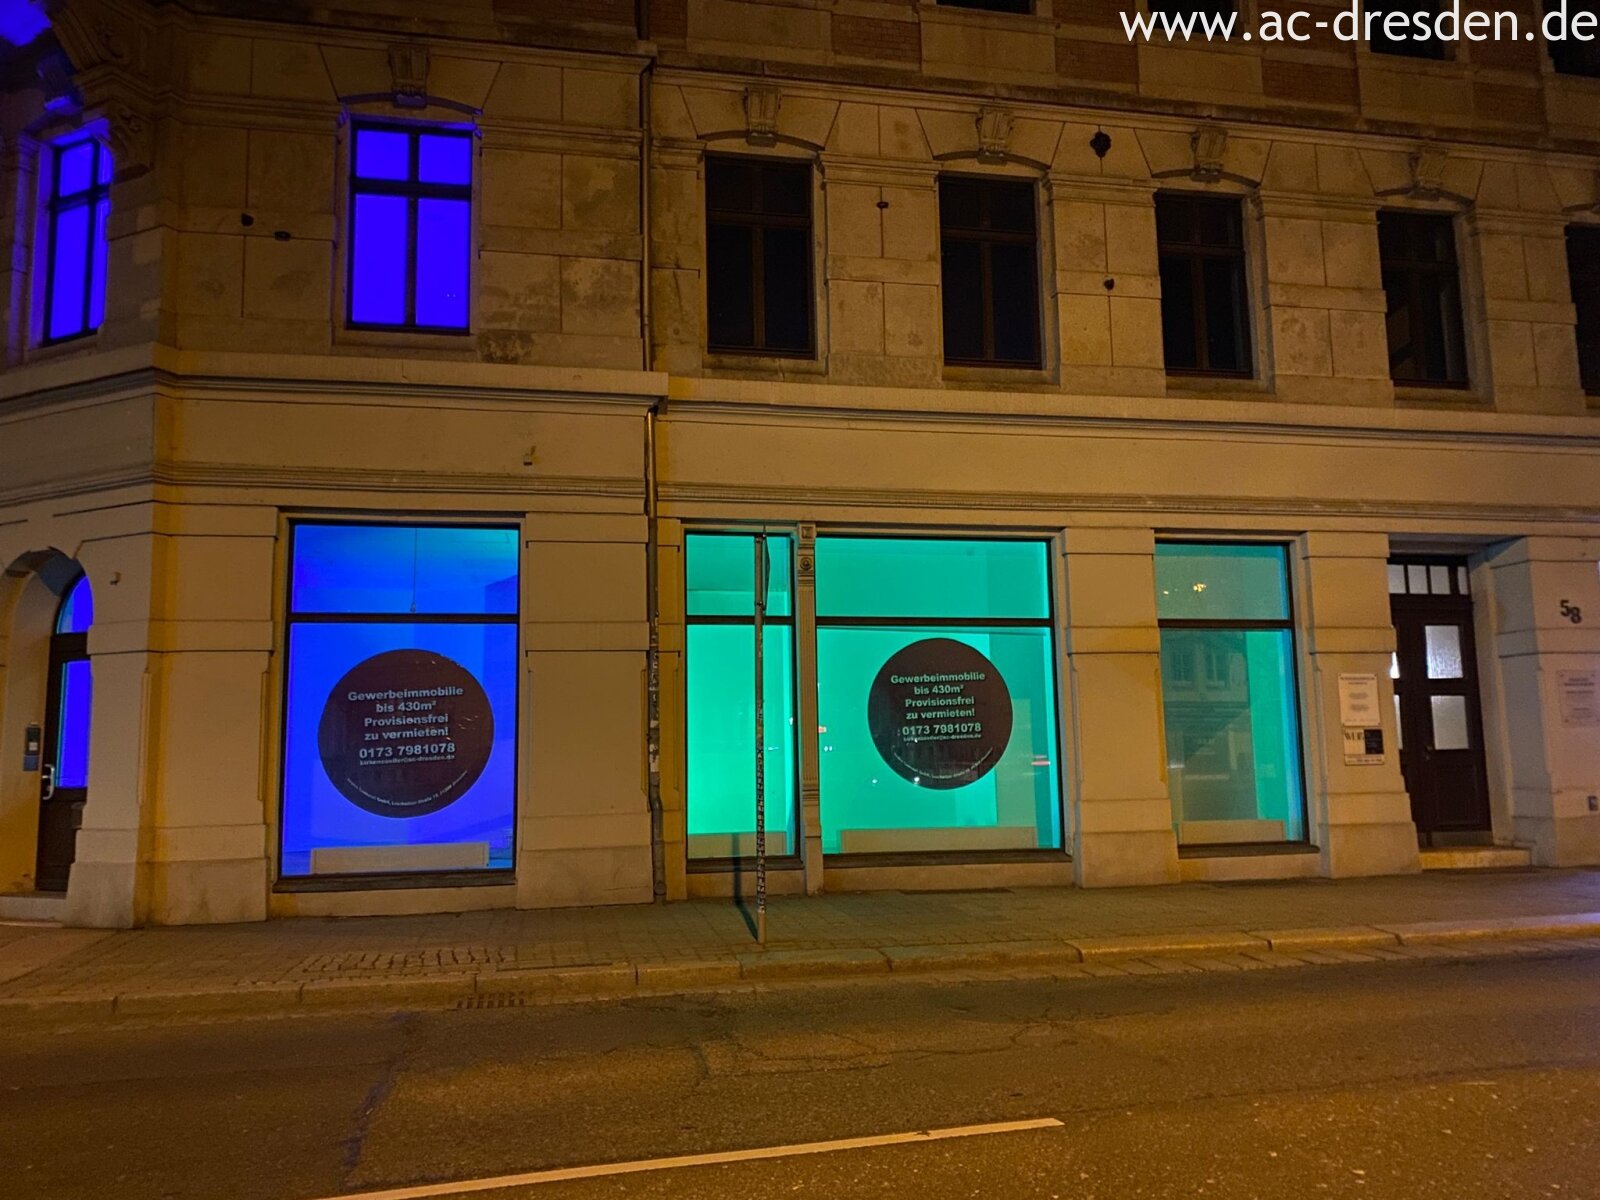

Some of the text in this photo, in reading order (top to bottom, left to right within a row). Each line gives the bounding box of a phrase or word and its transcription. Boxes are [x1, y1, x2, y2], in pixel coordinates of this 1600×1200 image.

[1560, 600, 1582, 624] 58
[892, 672, 985, 684] Gewerbeimmobilie
[348, 687, 464, 700] Gewerbeimmobilie
[914, 684, 964, 695] bis 430m²
[376, 701, 436, 713] bis 430m²
[905, 697, 974, 707] Provisionsfrei
[364, 714, 449, 726] Provisionsfrei
[906, 709, 975, 720] zu vermieten!
[364, 727, 449, 741] zu vermieten!
[902, 724, 981, 735] 0173 7981078
[359, 743, 456, 759] 0173 7981078
